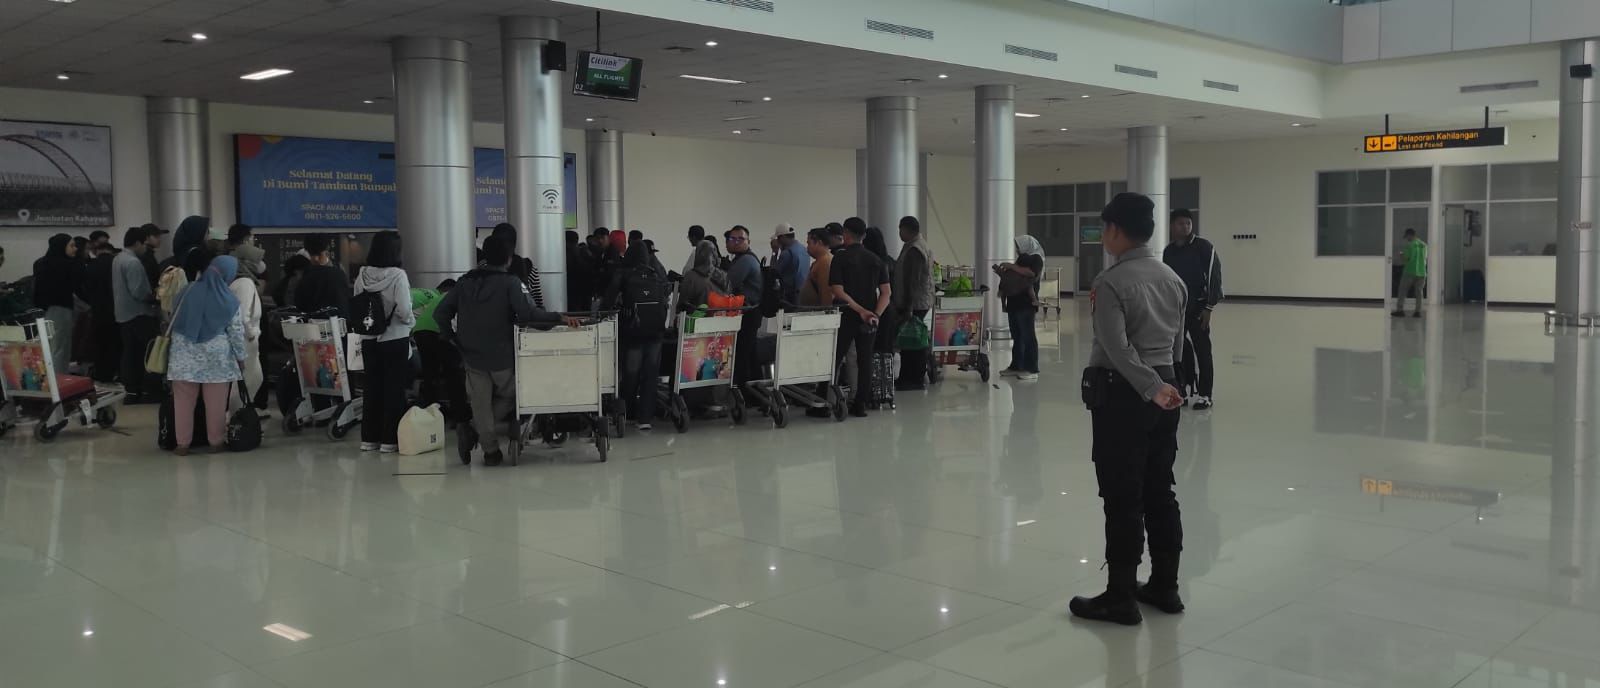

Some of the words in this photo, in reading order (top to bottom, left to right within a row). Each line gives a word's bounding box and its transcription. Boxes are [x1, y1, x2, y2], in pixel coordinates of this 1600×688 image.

[590, 56, 618, 67] Citilink
[603, 74, 624, 82] FLIGHTS
[575, 83, 584, 91] 02
[1398, 133, 1435, 143] Pelaporan
[1436, 131, 1479, 141] Kehilangan
[1424, 141, 1443, 149] Found
[289, 169, 333, 180] Selamat
[336, 171, 373, 182] Datang
[263, 179, 275, 190] Di
[278, 180, 309, 190] Bumi
[311, 181, 357, 191] Tambun
[302, 203, 325, 211] SPACE
[326, 204, 363, 212] AVAILABLE
